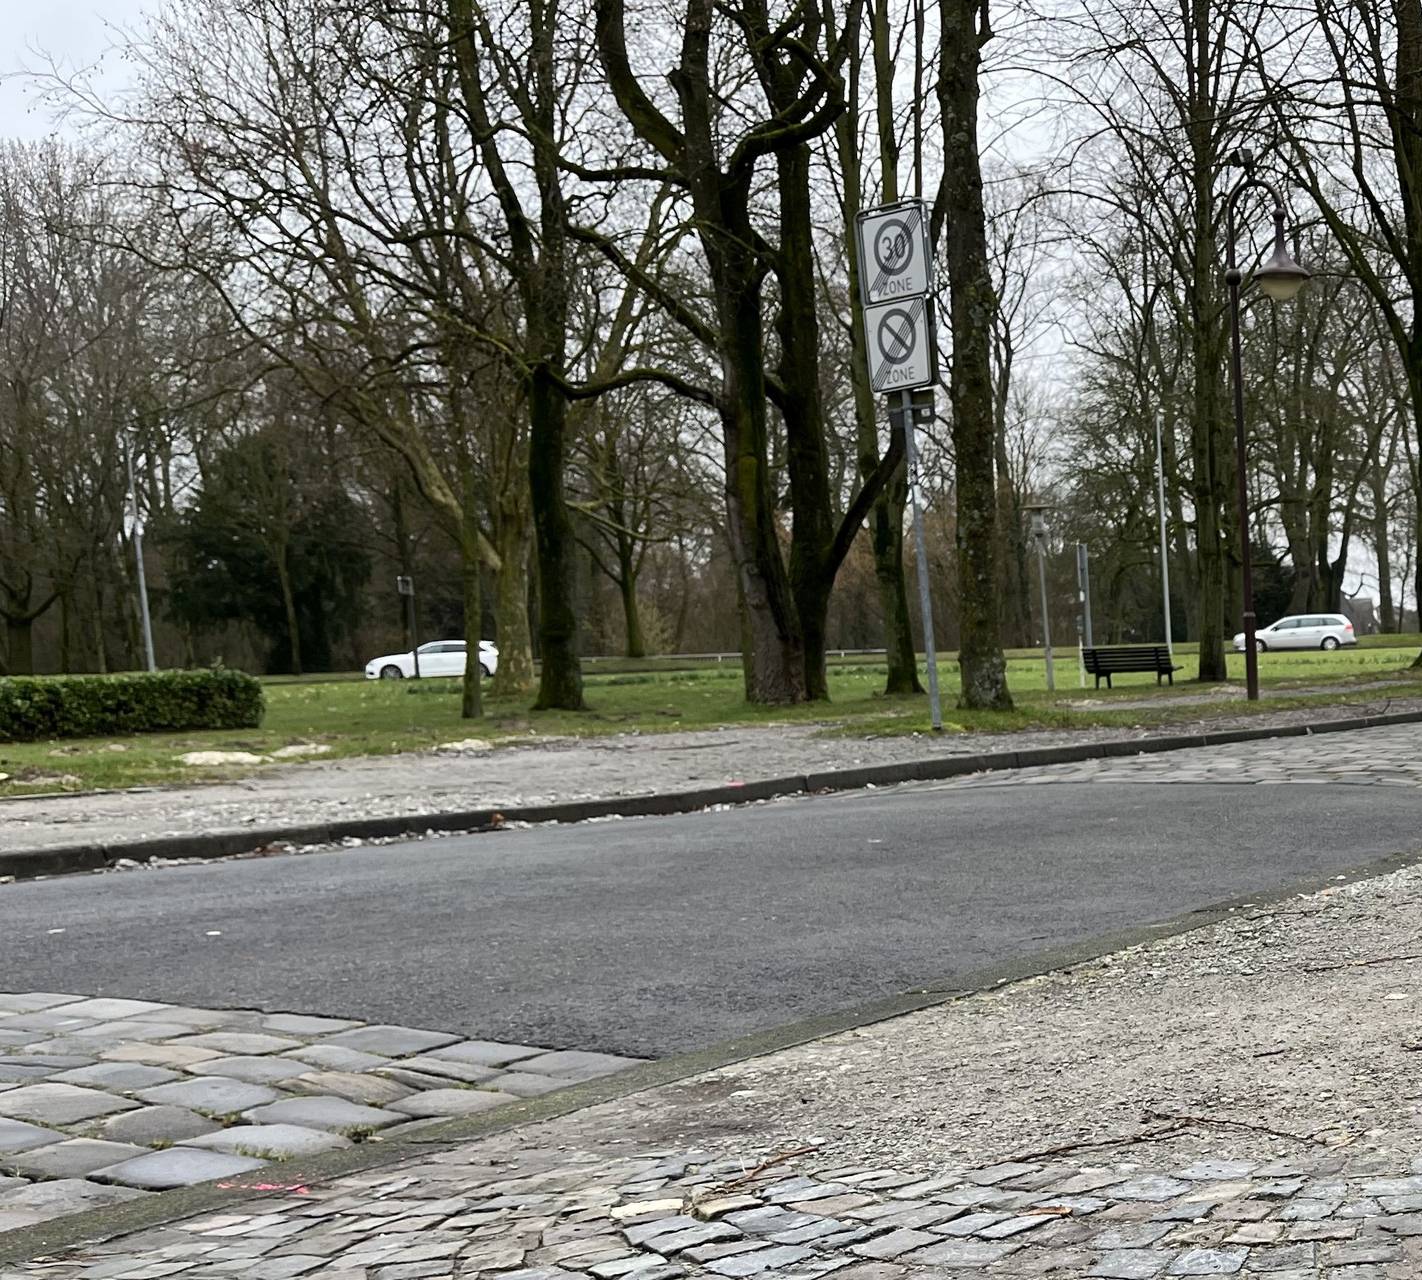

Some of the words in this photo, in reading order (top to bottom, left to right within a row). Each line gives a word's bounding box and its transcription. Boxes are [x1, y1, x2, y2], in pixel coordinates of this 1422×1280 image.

[882, 234, 905, 262] 30
[883, 277, 913, 296] ZONE
[886, 366, 916, 385] ZONE
